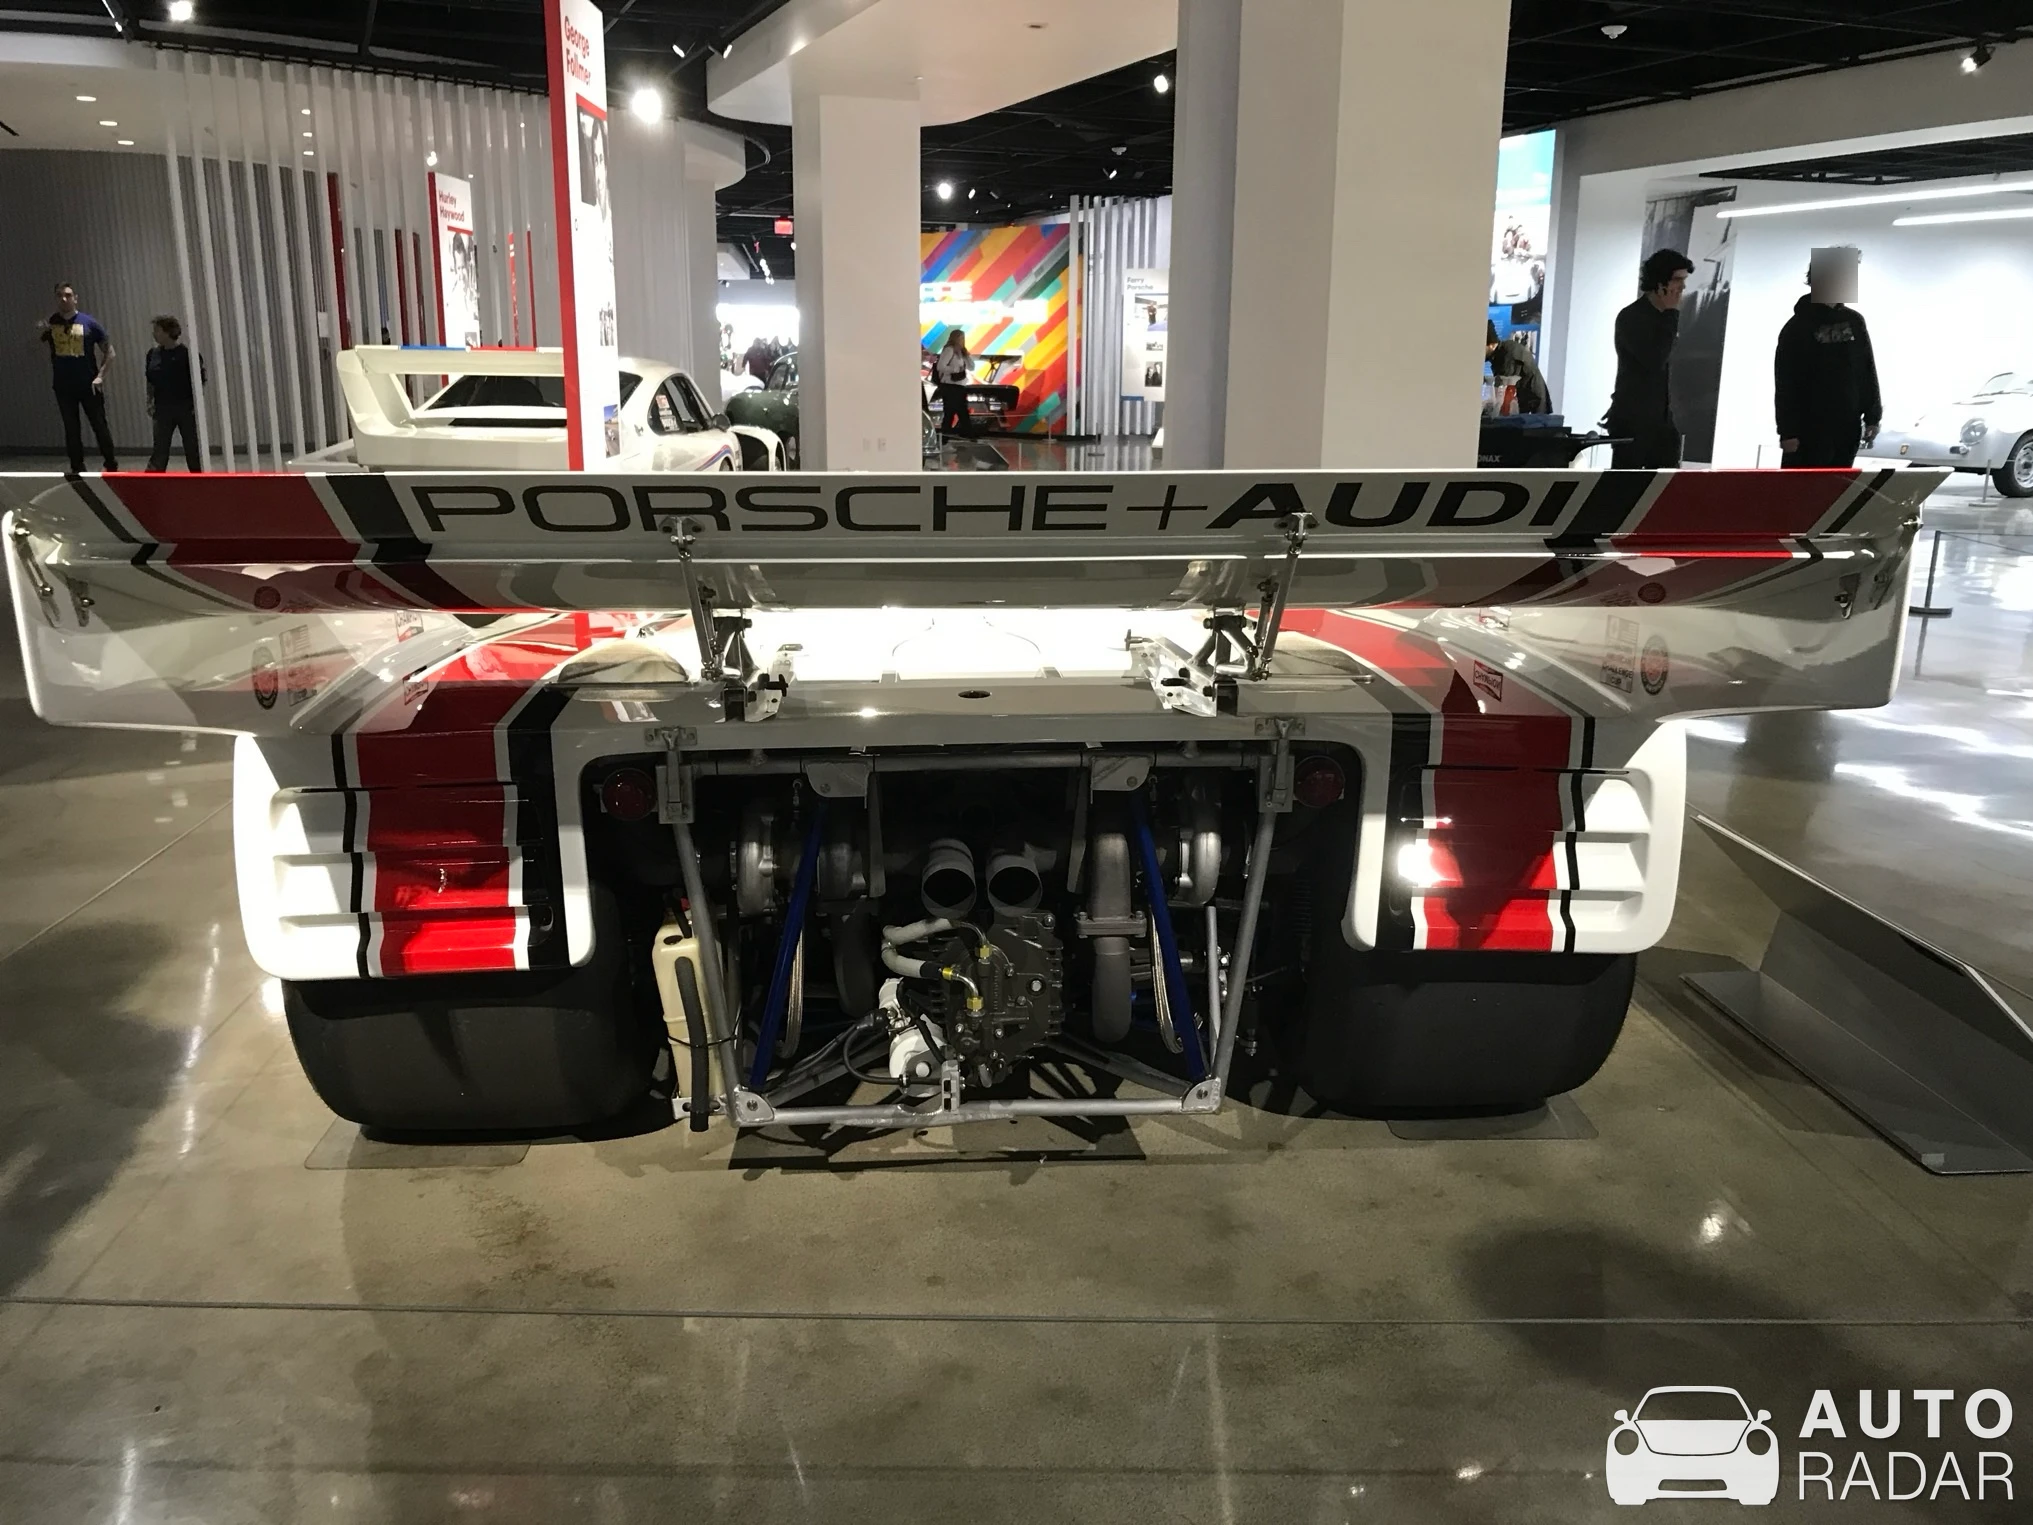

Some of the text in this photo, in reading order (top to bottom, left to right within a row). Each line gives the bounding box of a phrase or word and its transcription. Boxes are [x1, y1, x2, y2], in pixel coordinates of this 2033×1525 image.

[564, 16, 590, 58] George
[565, 48, 592, 86] Follmer
[438, 189, 457, 208] Hurley
[439, 206, 465, 223] Haywood
[1478, 455, 1500, 463] ONAX
